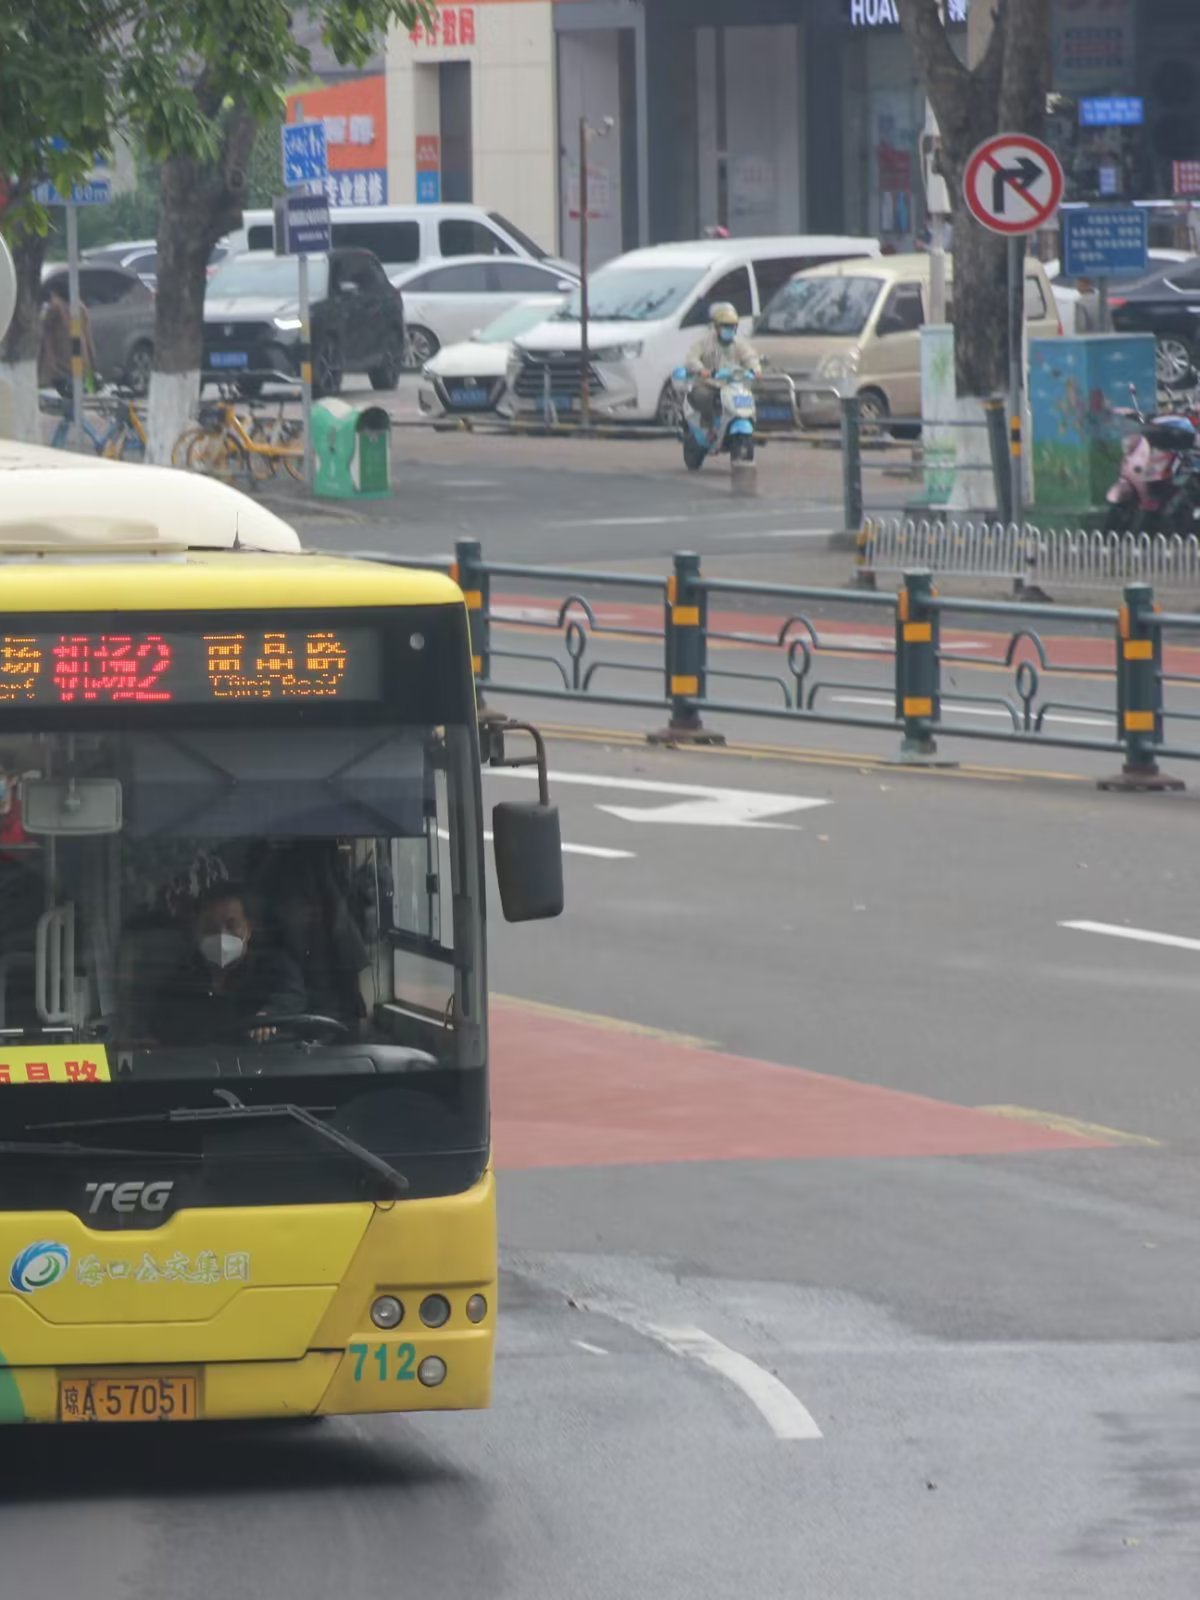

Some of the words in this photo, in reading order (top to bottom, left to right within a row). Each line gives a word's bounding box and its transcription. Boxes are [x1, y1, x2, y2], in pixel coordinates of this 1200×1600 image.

[851, 0, 900, 26] HUA
[84, 1181, 174, 1214] TEG
[75, 1250, 251, 1288] 海口公交集团
[348, 1342, 417, 1382] 712
